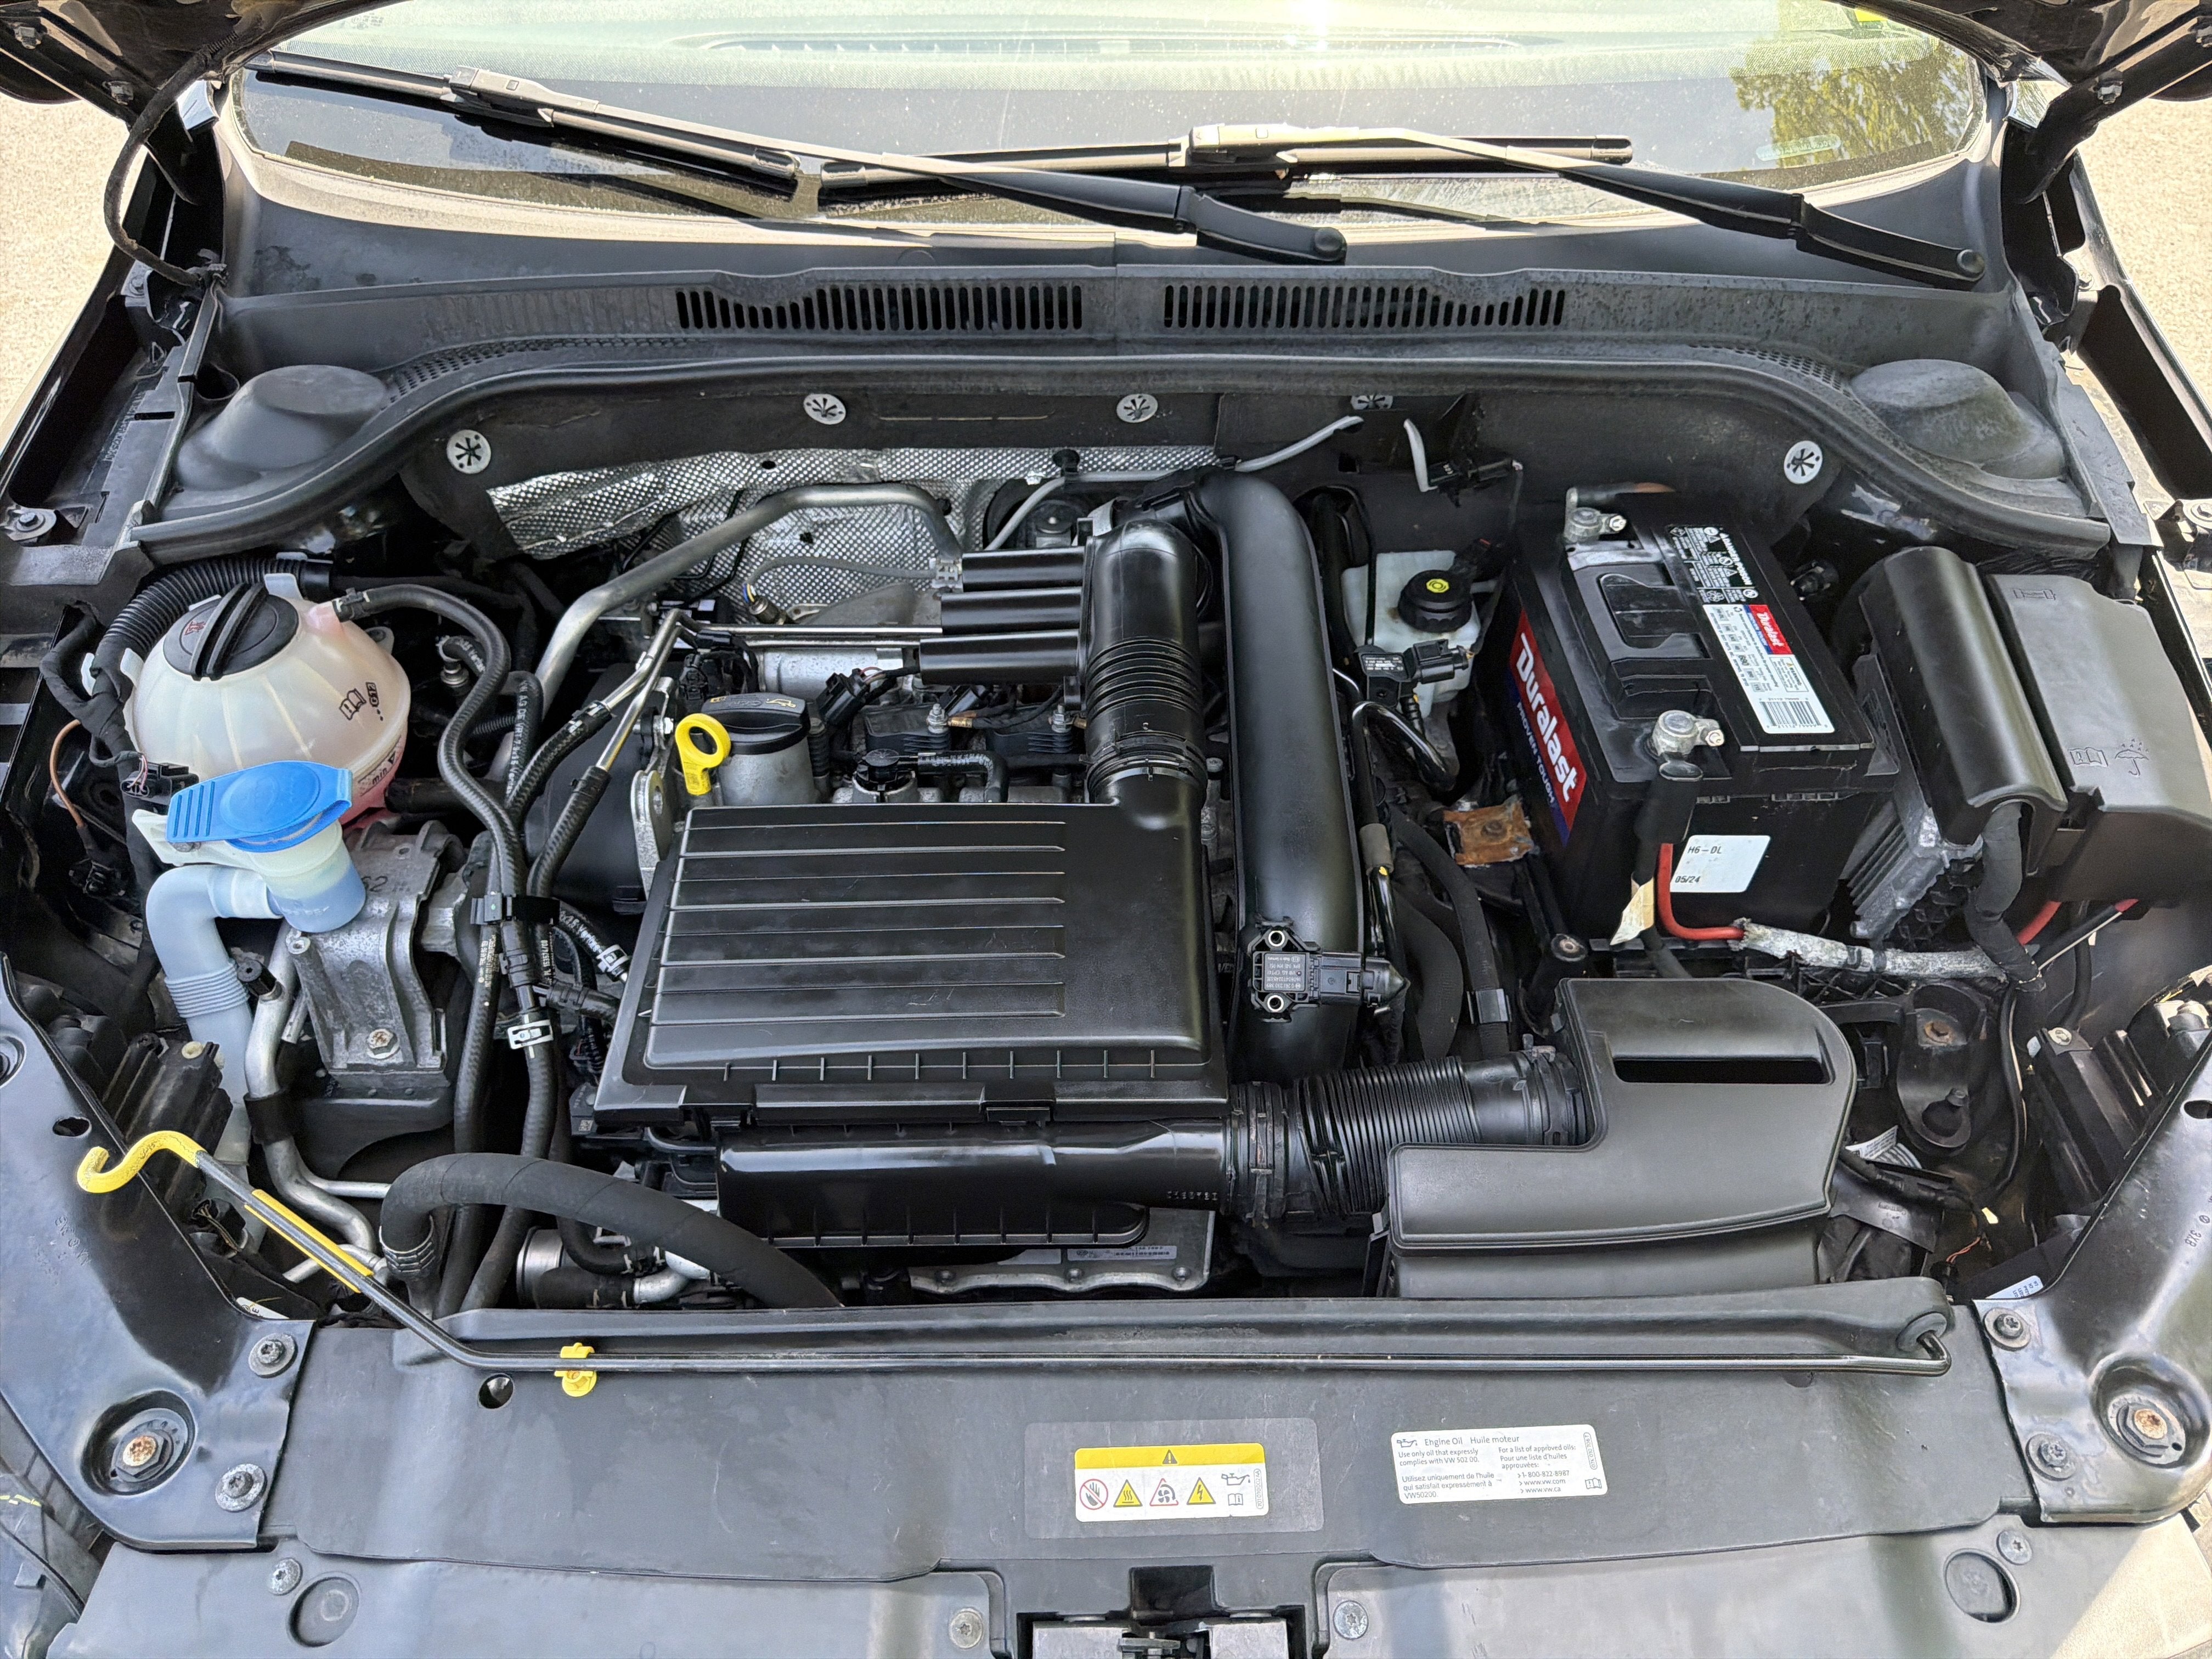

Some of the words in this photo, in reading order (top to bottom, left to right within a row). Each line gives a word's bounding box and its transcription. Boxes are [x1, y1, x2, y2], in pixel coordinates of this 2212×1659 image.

[1756, 613, 1784, 646] Duralast
[518, 695, 528, 707] AG
[1516, 633, 1577, 802] Duralast
[373, 768, 387, 785] min
[1424, 1437, 1451, 1447] Engine
[1452, 1437, 1463, 1445] Oil
[1470, 1436, 1491, 1444] Huile
[1492, 1435, 1520, 1443] moteur
[1449, 1448, 1479, 1456] expressly
[1533, 1444, 1562, 1453] approved
[1400, 1459, 1427, 1467] complies
[1502, 1462, 1539, 1470] approuvées:
[1427, 1473, 1465, 1482] uniquement
[1403, 1484, 1414, 1492] qui
[1441, 1480, 1486, 1490] expressément
